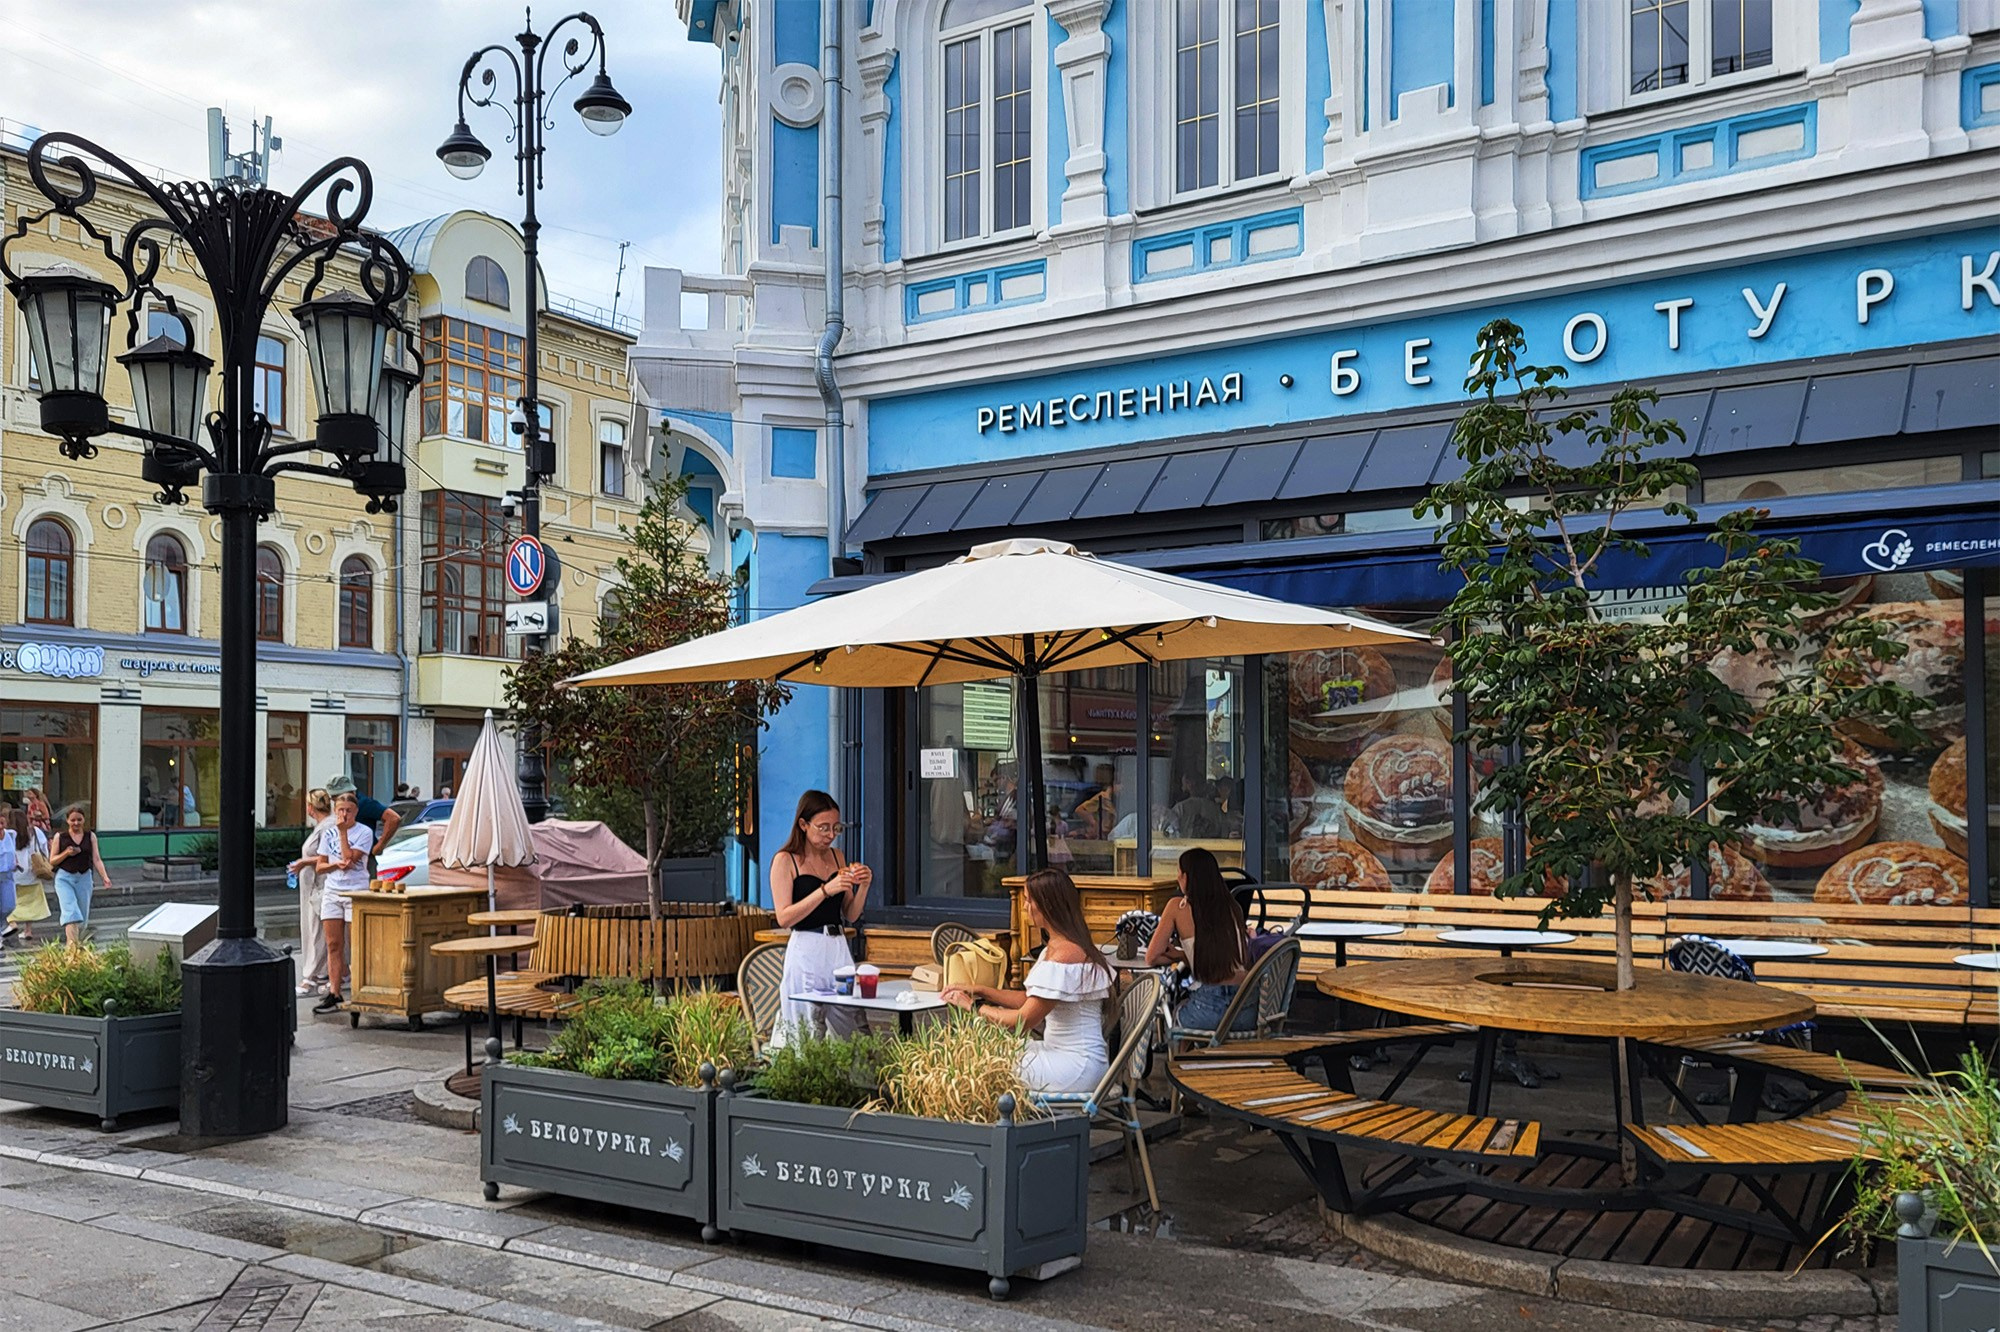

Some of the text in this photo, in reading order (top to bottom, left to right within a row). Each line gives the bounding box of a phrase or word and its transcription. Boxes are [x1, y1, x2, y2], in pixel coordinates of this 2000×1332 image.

[977, 371, 1243, 434] РЕМЕСЛЕННАЯ
[1601, 605, 1634, 618] ЦЕПТ
[121, 659, 176, 678] шаурма
[178, 661, 188, 673] и
[5, 1047, 75, 1071] БЕЛОТУРКА
[530, 1119, 651, 1156] БЕЛОТУРКА
[776, 1160, 931, 1202] БЕЛОТУРКА
